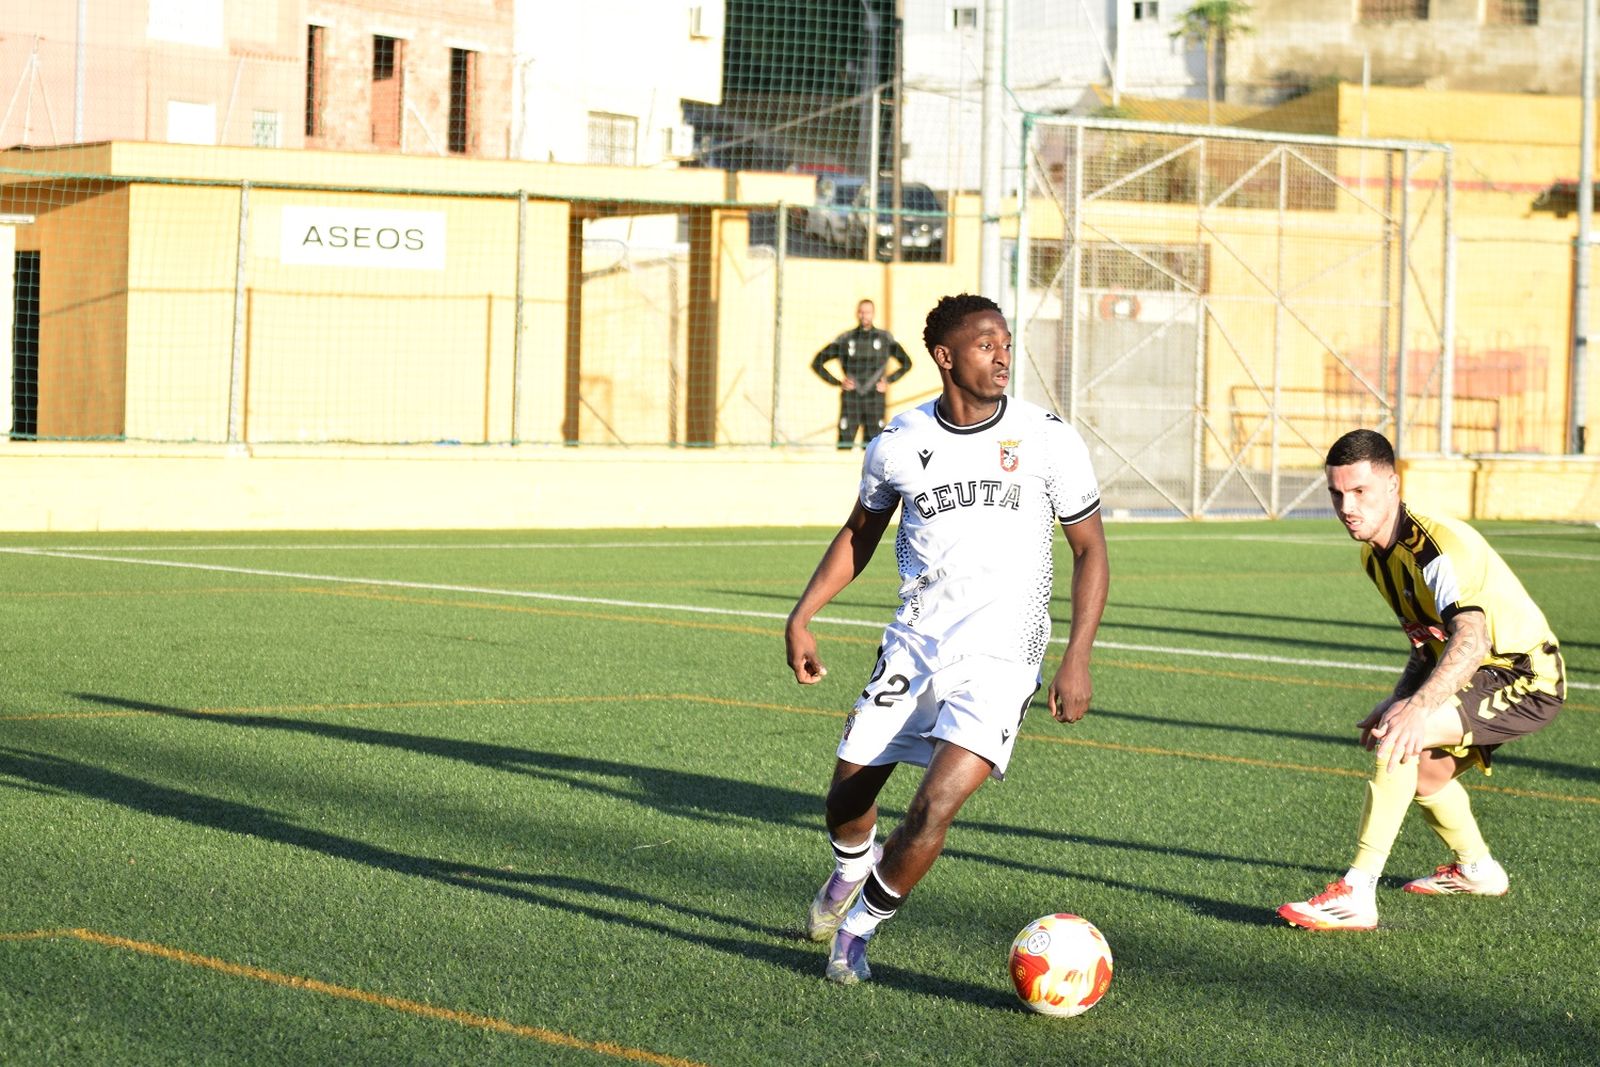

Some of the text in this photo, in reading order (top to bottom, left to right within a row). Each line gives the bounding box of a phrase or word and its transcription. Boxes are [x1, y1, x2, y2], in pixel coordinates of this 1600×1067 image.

[302, 225, 424, 251] ASEOS
[913, 479, 1021, 520] CEUTA
[906, 594, 921, 628] PUNTA
